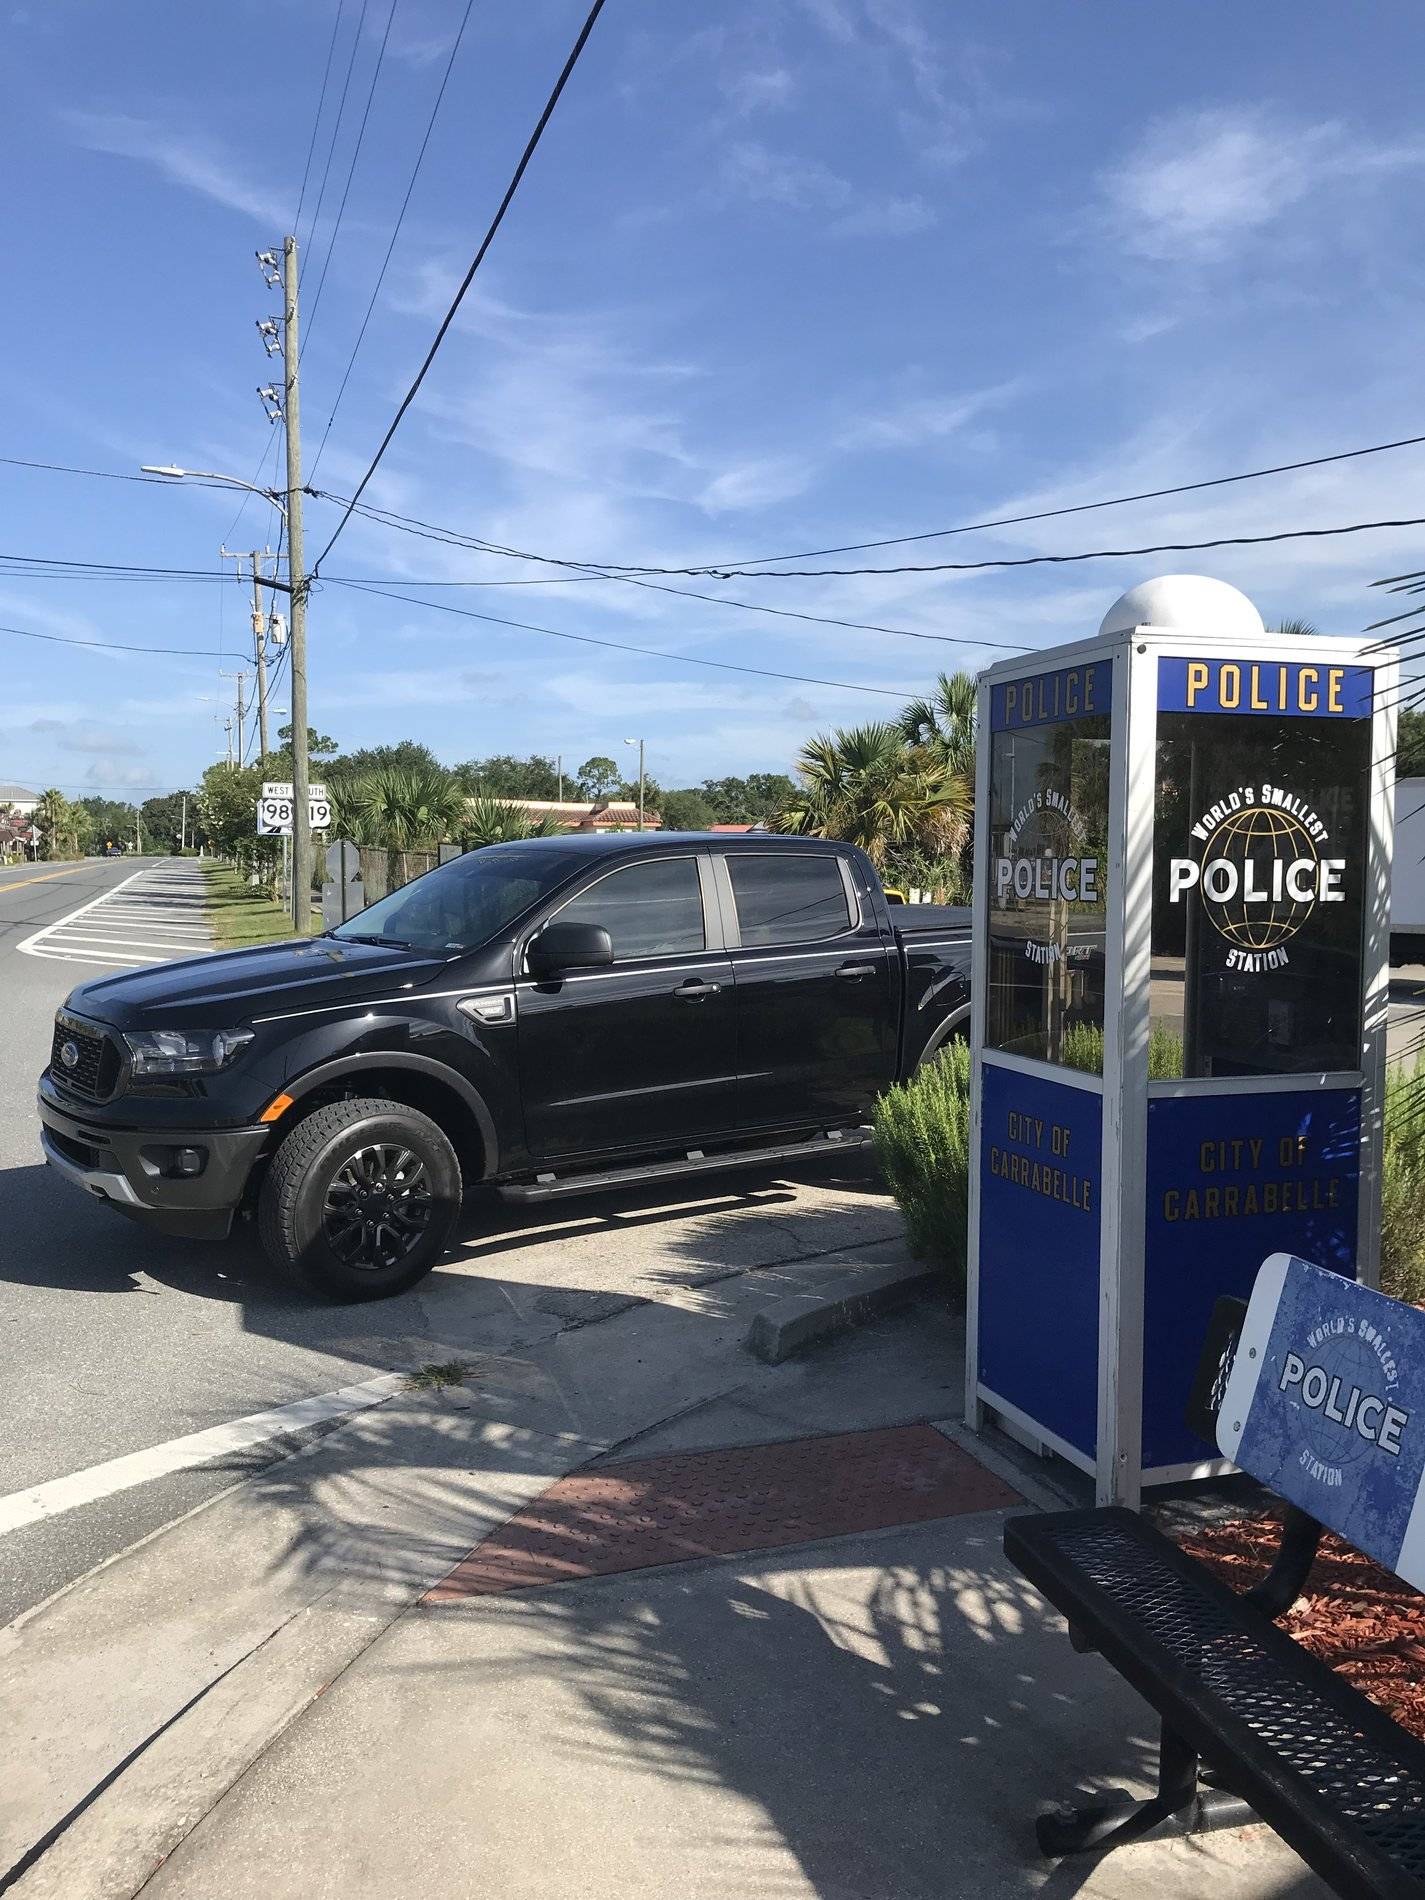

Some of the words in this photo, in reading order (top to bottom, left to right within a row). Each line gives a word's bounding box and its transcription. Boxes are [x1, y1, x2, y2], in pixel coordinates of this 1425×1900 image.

[1005, 668, 1096, 725] POLICE
[1186, 661, 1345, 713] POLICE
[266, 804, 289, 820] 98
[268, 786, 289, 795] WEST
[308, 788, 324, 796] UTH
[310, 806, 327, 821] 19
[1008, 792, 1043, 843] WORLD'S
[1190, 787, 1255, 842] WORLD'S
[1261, 784, 1329, 843] SMALLEST
[996, 857, 1099, 902] POLICE
[1169, 858, 1347, 903] POLICE
[1225, 947, 1290, 972] STATION
[1008, 1111, 1043, 1148] CITY
[1052, 1126, 1071, 1158] OF
[1200, 1139, 1264, 1174] CITY
[1279, 1136, 1306, 1168] OF
[990, 1146, 1092, 1212] CARRABELLE
[1163, 1178, 1341, 1222] CARRABELLE
[1306, 1315, 1355, 1349] WORLD'S
[1358, 1319, 1399, 1392] SMALLEST
[1279, 1352, 1409, 1456] POLICE
[1299, 1448, 1342, 1487] STATION
